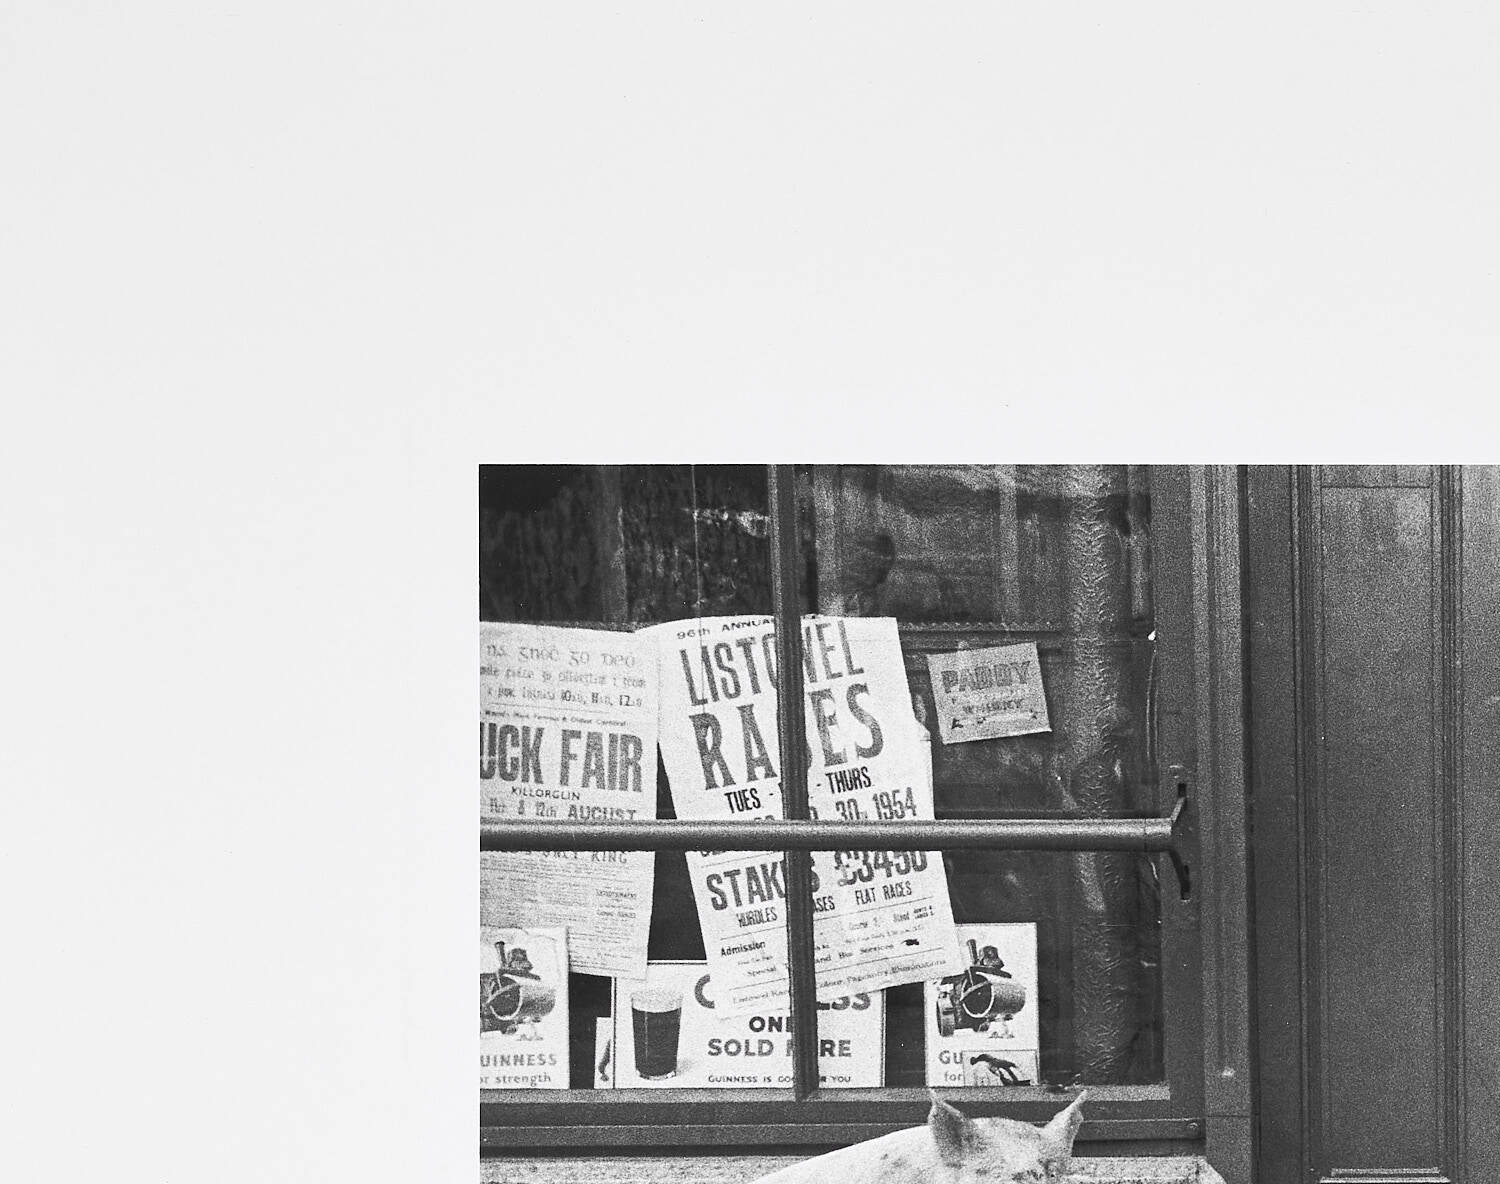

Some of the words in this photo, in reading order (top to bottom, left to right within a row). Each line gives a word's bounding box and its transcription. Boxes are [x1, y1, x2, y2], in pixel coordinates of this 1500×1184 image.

[677, 628, 711, 641] 96th
[721, 617, 775, 633] ANNUA
[940, 660, 1031, 694] PADDY
[688, 682, 884, 791] RAES
[559, 728, 643, 793] FAIR
[510, 785, 581, 801] KILLORGLIN
[872, 786, 918, 821] 1954
[567, 804, 637, 820] AUGUST
[855, 887, 876, 906] FLAT
[882, 880, 912, 901] RACES
[721, 941, 766, 956] Admission
[708, 1038, 775, 1057] SOLD
[786, 1039, 852, 1057] HRE
[495, 1071, 552, 1088] strength
[708, 1075, 758, 1083] GUINNESS
[763, 1075, 772, 1083] IS
[830, 1075, 851, 1083] YOU
